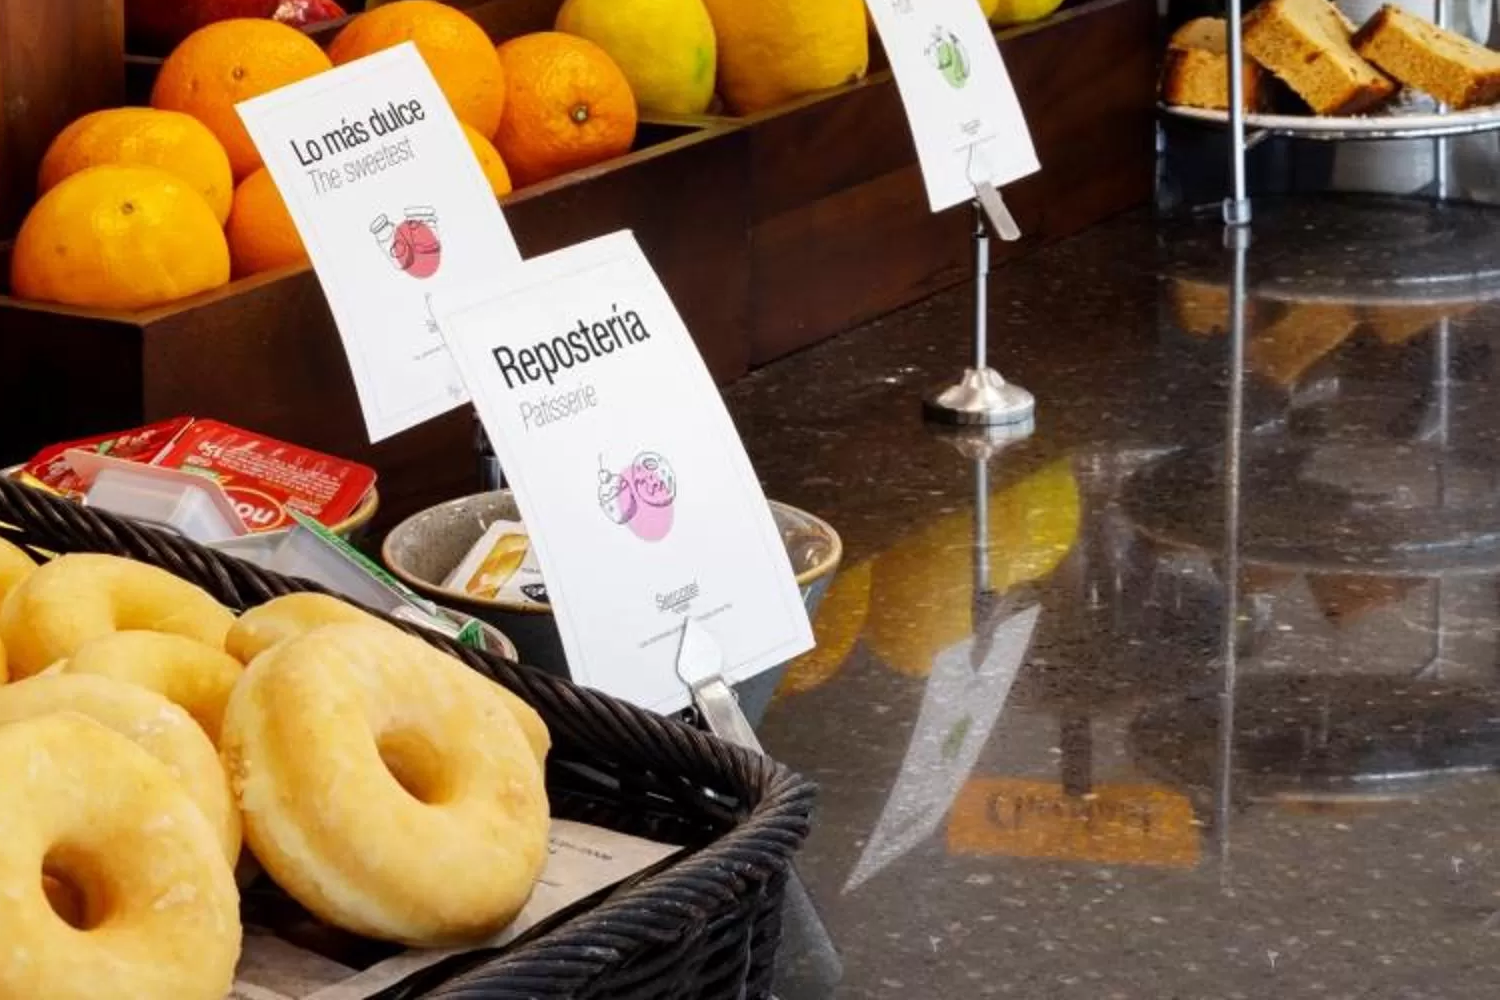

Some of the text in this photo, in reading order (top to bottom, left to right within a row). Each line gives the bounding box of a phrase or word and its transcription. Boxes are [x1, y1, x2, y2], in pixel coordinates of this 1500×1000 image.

[290, 98, 425, 166] Lo más dulce
[306, 136, 415, 195] The sweetest
[491, 303, 651, 390] Repostería
[518, 383, 598, 434] Patisserie
